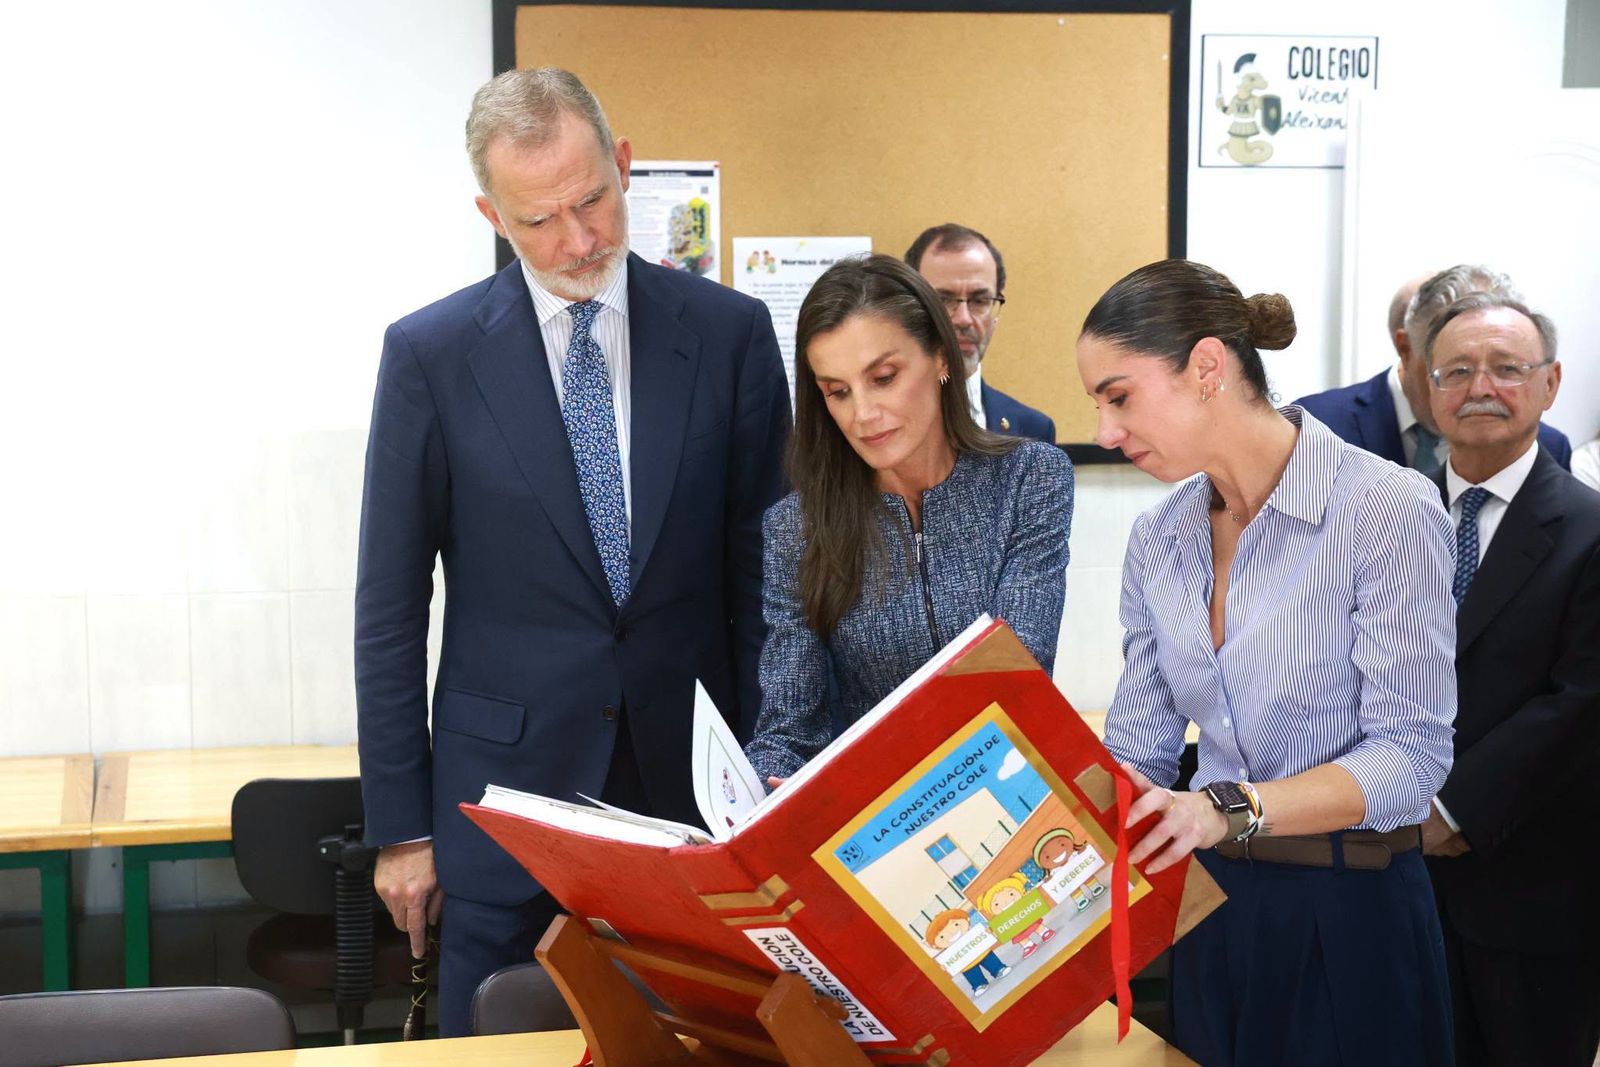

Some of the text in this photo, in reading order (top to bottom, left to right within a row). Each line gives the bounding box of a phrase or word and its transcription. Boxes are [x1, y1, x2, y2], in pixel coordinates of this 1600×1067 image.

[1288, 46, 1370, 80] COLEGIO
[872, 734, 1000, 843] LA CONSTITUACIÓN DE
[904, 763, 988, 836] NUESTRO COLE
[1051, 854, 1097, 894] Y DEBERES
[997, 898, 1042, 934] DERECHOS
[945, 931, 988, 967] NUESTROS
[775, 933, 884, 1036] DE NUESTRO COLE
[844, 1020, 864, 1036] LA
